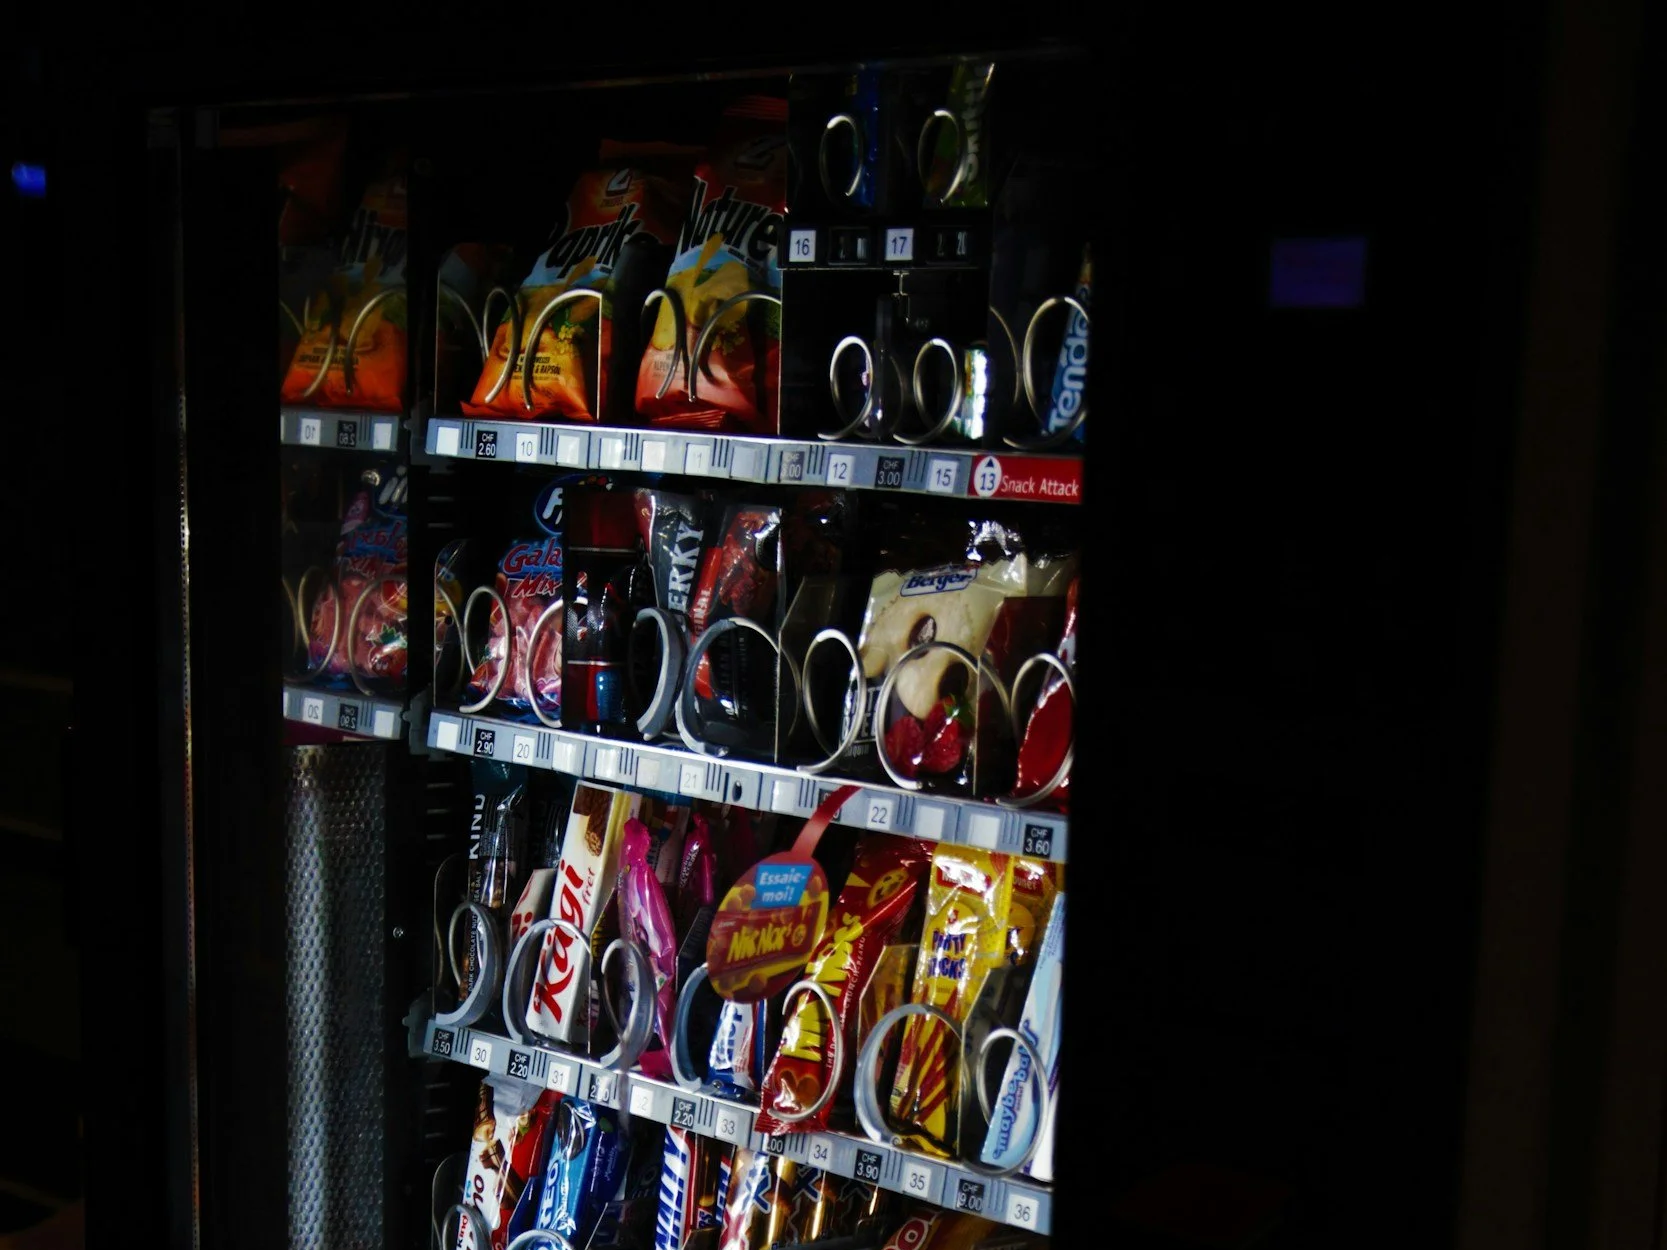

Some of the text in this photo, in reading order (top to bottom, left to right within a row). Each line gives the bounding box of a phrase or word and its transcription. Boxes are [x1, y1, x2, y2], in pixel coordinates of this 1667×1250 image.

[795, 239, 810, 256] 16
[891, 236, 907, 254] 17
[480, 432, 495, 443] CHF
[477, 442, 496, 457] 2.60
[520, 440, 533, 456] 10
[831, 463, 848, 479] 12
[882, 459, 900, 471] CHF
[877, 470, 900, 486] 3.00
[935, 469, 952, 487] 15
[979, 472, 997, 491] 13
[1001, 476, 1080, 498] Snack Attack
[512, 571, 563, 598] Mix
[906, 572, 972, 592] Berger
[480, 731, 493, 741] CHF
[476, 740, 494, 756] 2.90
[517, 743, 530, 760] 20
[683, 772, 698, 788] 21
[871, 806, 888, 825] 22
[469, 794, 486, 860] KIND
[1031, 826, 1049, 838] CHF
[1025, 837, 1050, 854] 3.60
[759, 869, 806, 885] Essaie-
[762, 886, 794, 903] moi!
[437, 1030, 450, 1040] CHF
[433, 1039, 450, 1054] 3.50
[474, 1047, 487, 1062] 30
[514, 1053, 528, 1064] CHF
[510, 1062, 528, 1077] 2.20
[551, 1070, 564, 1085] 31
[678, 1100, 693, 1111] CHF
[674, 1111, 694, 1127] 2.20
[720, 1119, 735, 1135] 33
[813, 1144, 828, 1160] 34
[861, 1152, 877, 1165] CHF
[856, 1162, 879, 1180] 3.90
[909, 1173, 925, 1191] 35
[962, 1181, 980, 1194] CHF
[1014, 1202, 1031, 1222] 36
